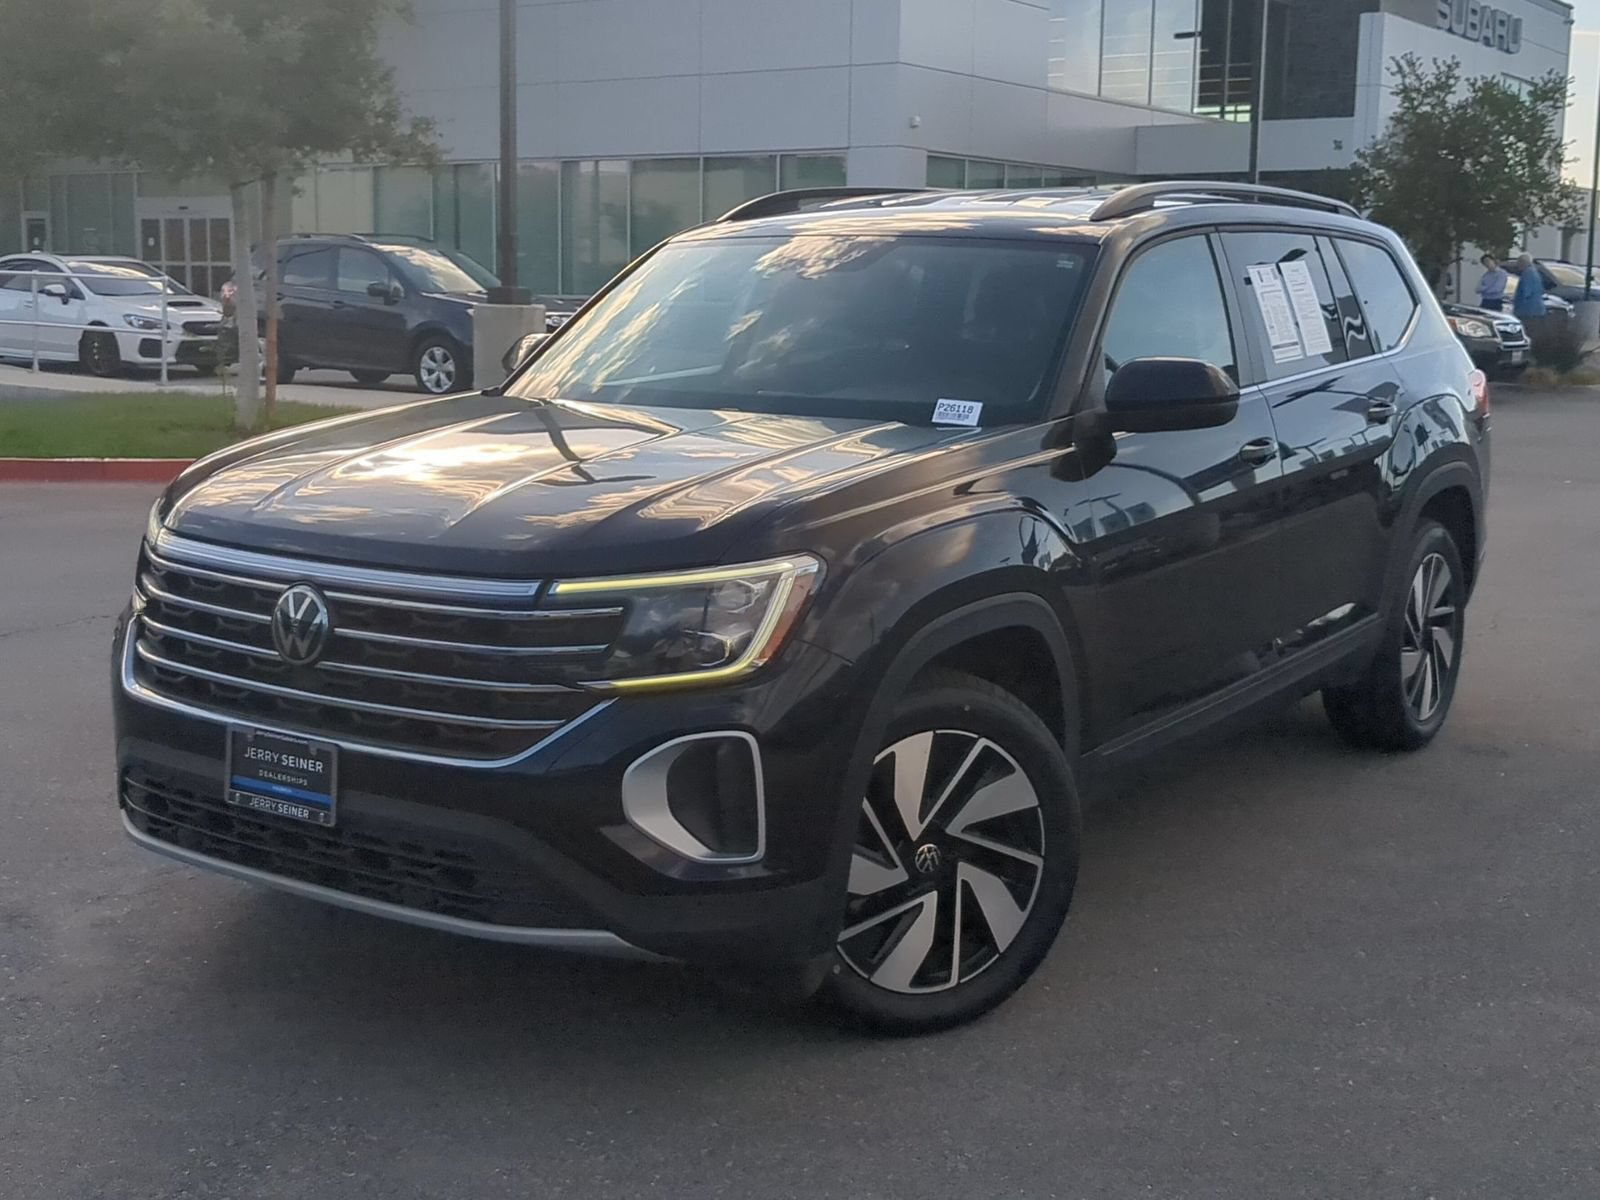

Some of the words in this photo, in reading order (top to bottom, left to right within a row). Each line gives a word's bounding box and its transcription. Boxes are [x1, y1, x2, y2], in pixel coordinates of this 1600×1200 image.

[1436, 0, 1522, 54] SUBARU
[938, 403, 974, 414] P26118
[244, 747, 280, 763] JERRY
[281, 754, 323, 773] SEINER
[258, 769, 308, 786] DEALERSHIPS
[249, 797, 278, 810] JERRY
[278, 803, 309, 819] SEINER
